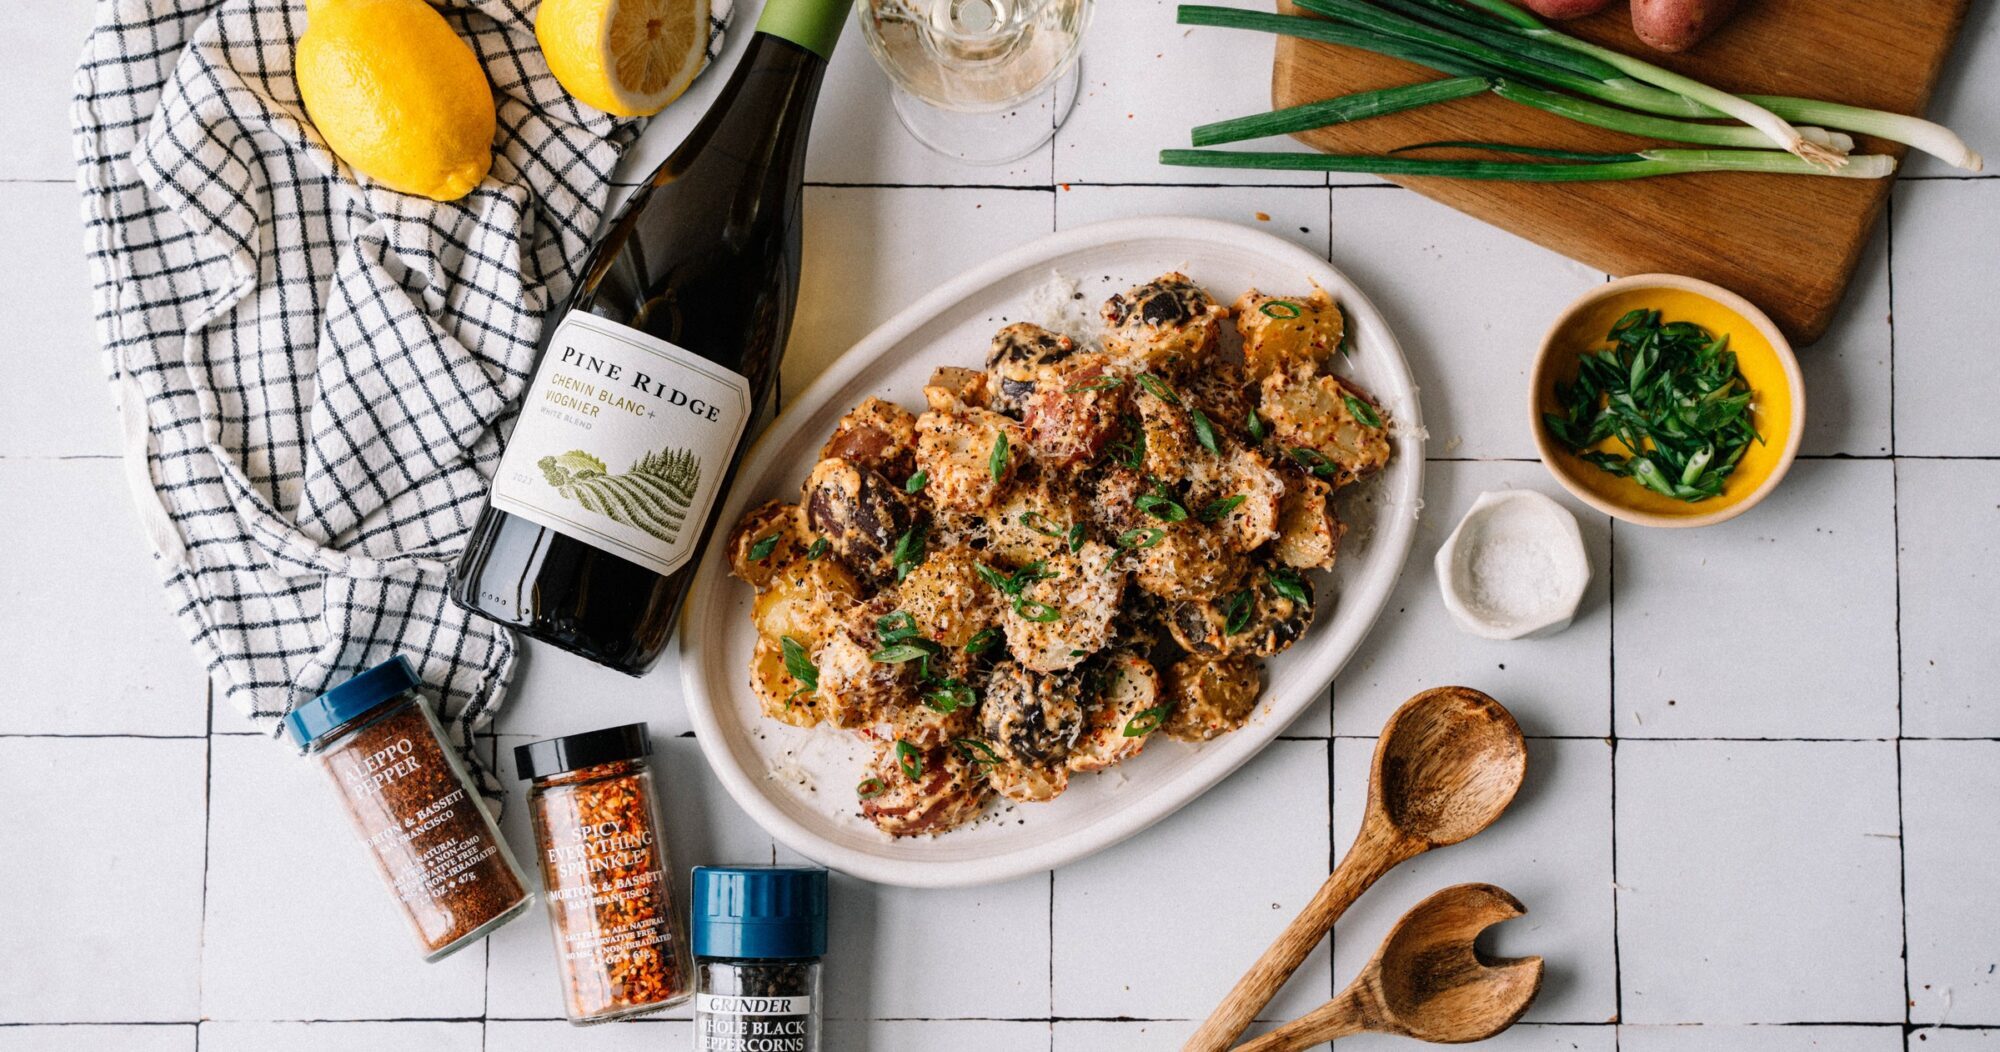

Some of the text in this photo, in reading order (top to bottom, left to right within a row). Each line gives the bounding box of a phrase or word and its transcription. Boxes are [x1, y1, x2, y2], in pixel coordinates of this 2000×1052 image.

[551, 373, 595, 397] CHENIN
[598, 389, 646, 417] BLANC
[561, 346, 721, 422] PINE RIDGE
[546, 389, 600, 418] VIOGNIER
[540, 406, 592, 430] WHITE BLEND
[345, 738, 413, 784] ALEPPO
[354, 755, 422, 799] PEPPER
[366, 788, 465, 849] ORTON & BASSETT
[398, 809, 455, 845] FRANCISCO
[571, 819, 622, 842] SPICY
[416, 837, 459, 864] NATURAL
[435, 834, 480, 863] NON-GMO
[456, 845, 479, 861] FREE
[548, 830, 653, 862] EVERYTHING
[425, 845, 497, 890] NON-IRRADIATED
[432, 885, 448, 898] OZ
[458, 871, 477, 885] 47g
[550, 870, 663, 901] MORTON & BASSETT
[568, 887, 650, 911] SAN FRANCISCO
[612, 924, 628, 934] ALL
[629, 916, 665, 930] NATURAL
[637, 927, 657, 937] FREE
[603, 933, 672, 953] NON-IRRADIATED
[633, 949, 651, 960] 61g
[710, 997, 791, 1013] GRINDER
[705, 1020, 806, 1036] HOLE BLACK
